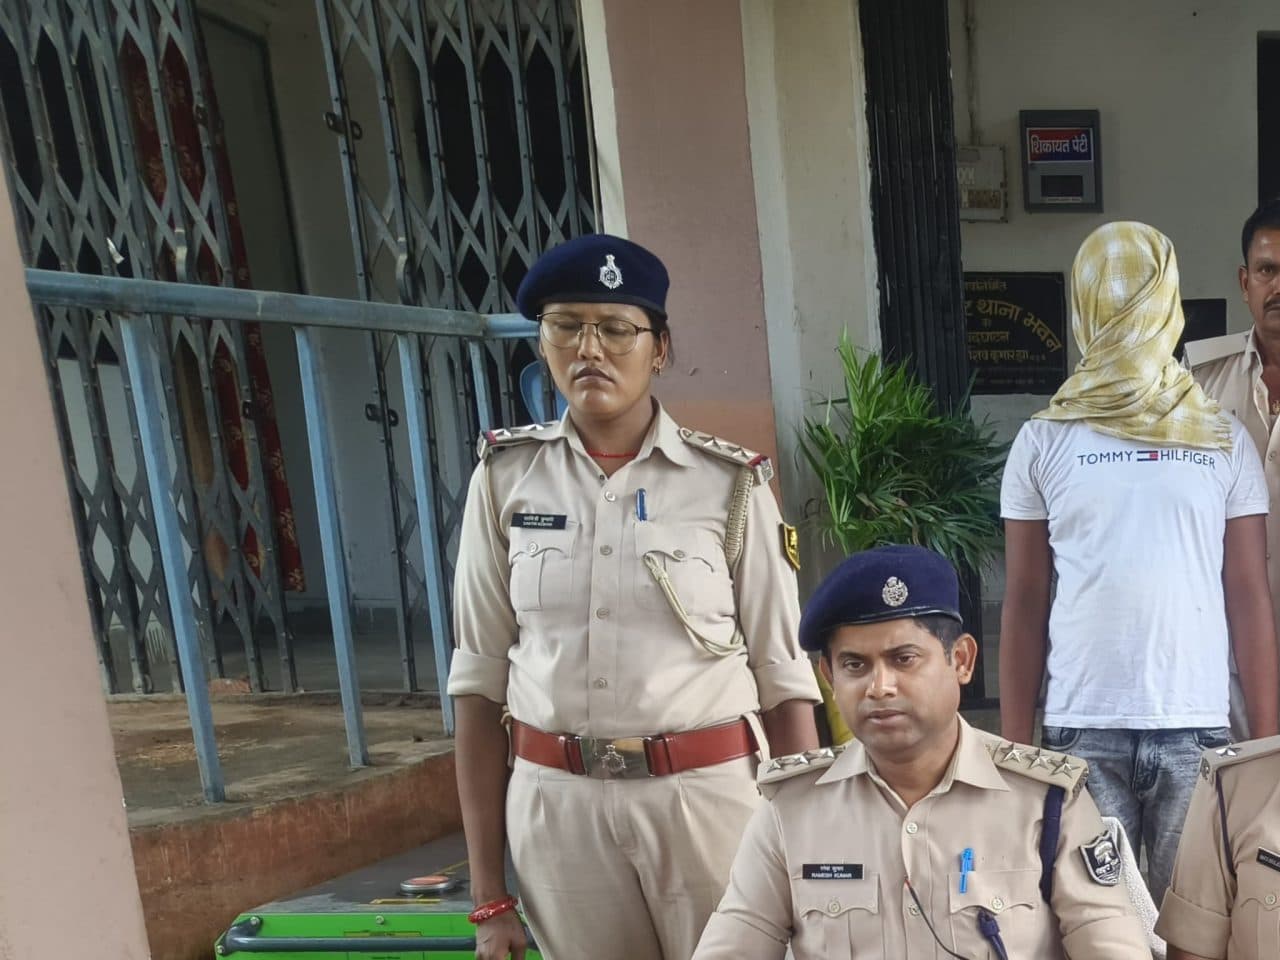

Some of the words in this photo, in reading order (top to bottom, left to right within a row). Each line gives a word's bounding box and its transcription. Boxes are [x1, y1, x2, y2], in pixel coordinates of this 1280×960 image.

[1031, 134, 1070, 153] शिकायत
[1071, 133, 1088, 153] पेटी
[976, 299, 1023, 321] थाना
[1023, 311, 1062, 353] भवन
[1078, 450, 1133, 466] TOMMY
[1160, 449, 1216, 470] HILFIGER
